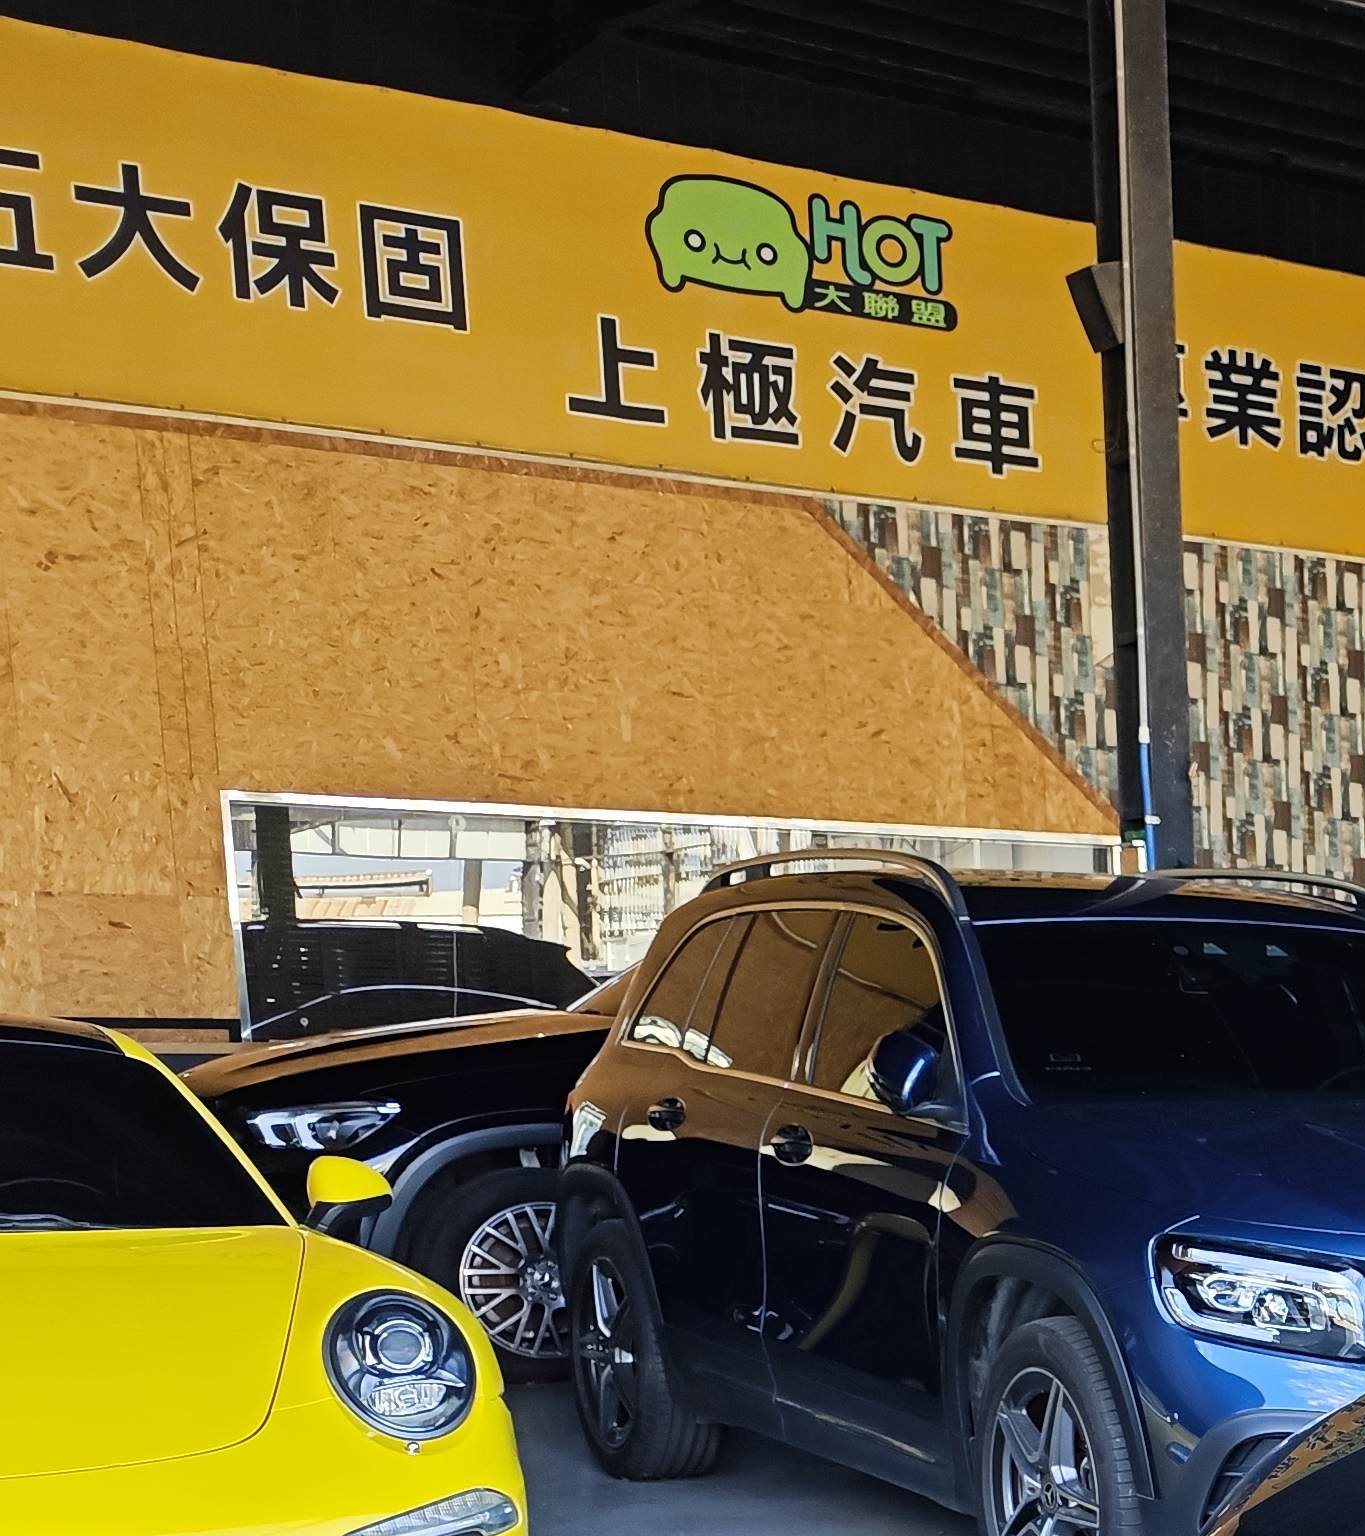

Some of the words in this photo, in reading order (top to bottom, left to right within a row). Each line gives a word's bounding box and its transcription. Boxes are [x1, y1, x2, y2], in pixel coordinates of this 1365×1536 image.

[808, 193, 952, 295] HOT
[813, 285, 947, 329] 大聯盟
[567, 315, 1041, 476] 上極汽車
